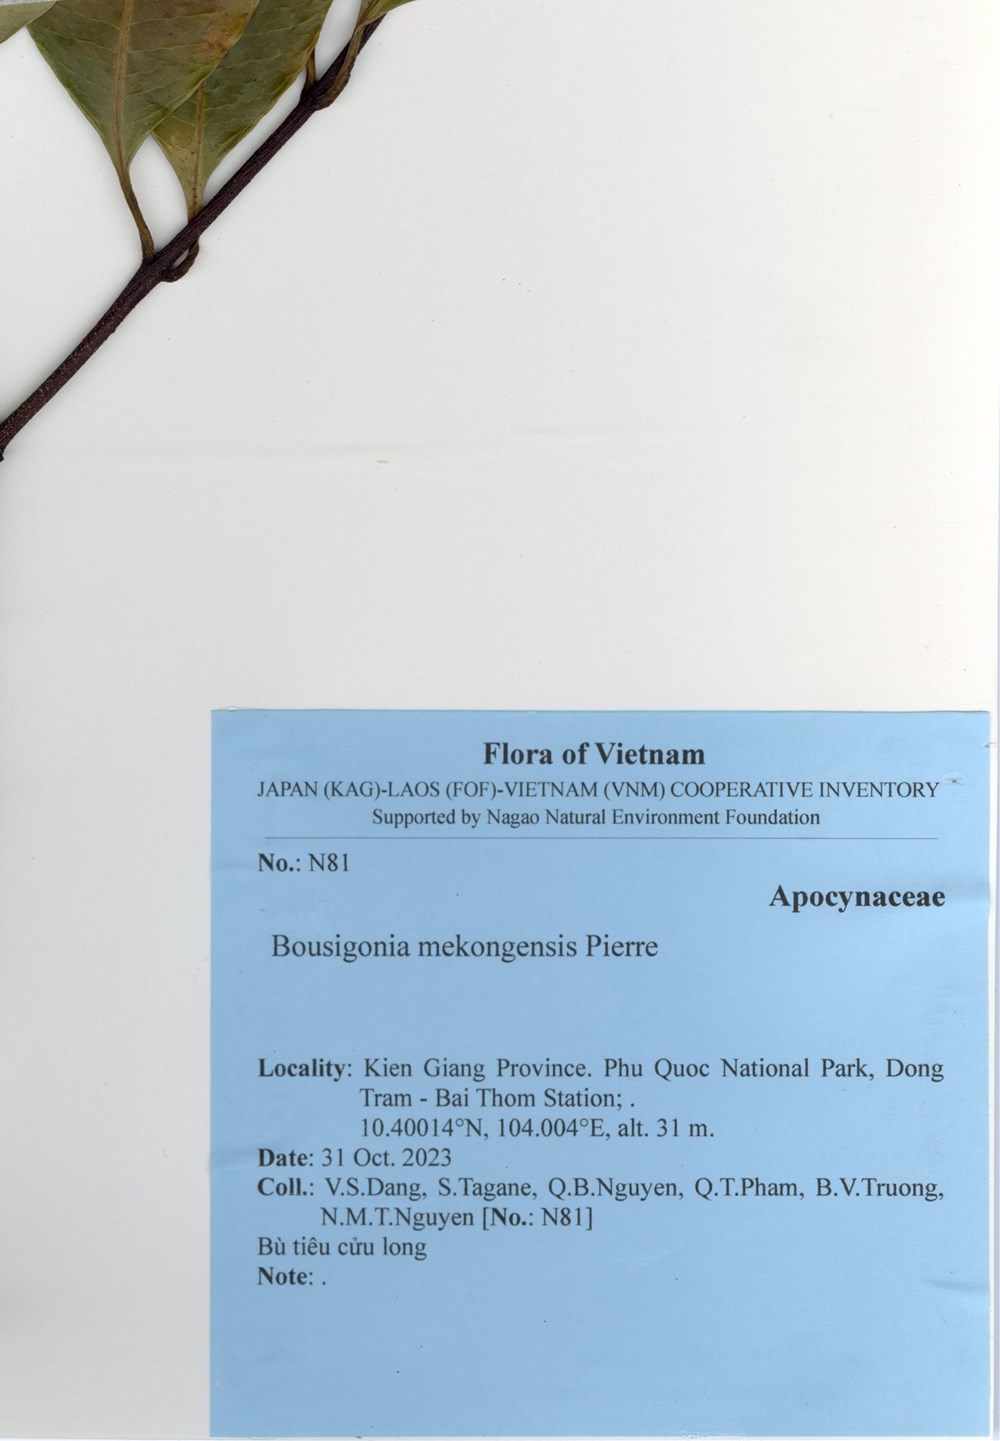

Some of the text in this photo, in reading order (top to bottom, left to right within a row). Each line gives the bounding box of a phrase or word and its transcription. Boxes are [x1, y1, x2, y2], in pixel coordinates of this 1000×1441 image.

[483, 741, 706, 766] Flora of Vietnam
[257, 780, 940, 801] JAPAN (KAG)-LAOS (FOF)-VIETNAM (VNM) COOPERATIVE INVENTORY
[372, 808, 821, 829] Supported by Nagao Natural Environment Foundation
[258, 852, 349, 873] No.: N81
[768, 884, 946, 914] Apocynaceae
[271, 933, 659, 964] Bousigonia mekongensis Pierre
[258, 1057, 945, 1083] Locality: Kien Giang Province. Phu Quoc National Park, Dong
[359, 1087, 412, 1108] Tram
[435, 1087, 469, 1108] Bai
[475, 1087, 536, 1108] Thom
[544, 1087, 622, 1111] Station;
[362, 1117, 714, 1141] 10.40014°N, 104.004°E, alt. 31 m.
[257, 1147, 452, 1167] Date: 31 Oct. 2023
[256, 1176, 944, 1203] Coll.: V.S.Dang, S.Tagane, Q.B.Nguyen, Q.T.Pham, B.V.Truong,
[320, 1206, 593, 1232] N.M.T.Nguyen [No.: N81]
[258, 1236, 428, 1261] Bù tiêu cửu long
[257, 1266, 313, 1286] Note:
